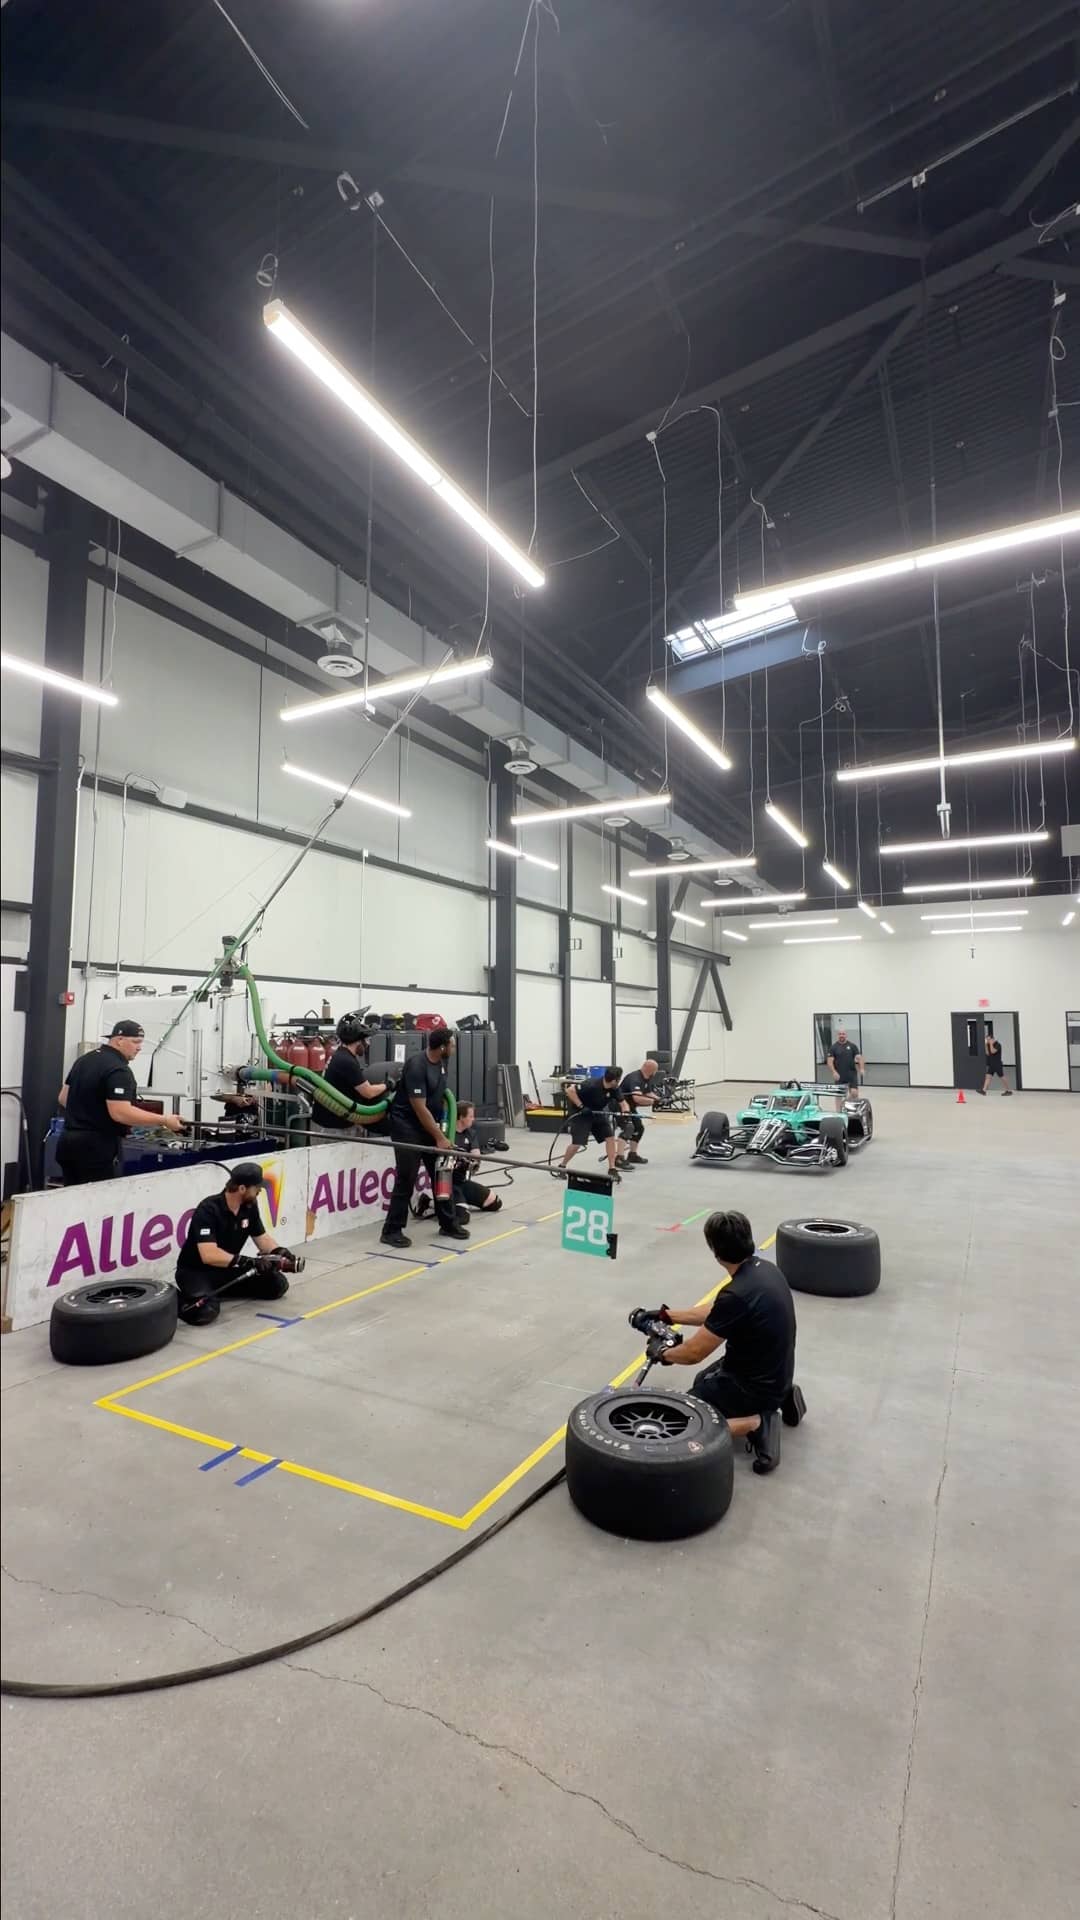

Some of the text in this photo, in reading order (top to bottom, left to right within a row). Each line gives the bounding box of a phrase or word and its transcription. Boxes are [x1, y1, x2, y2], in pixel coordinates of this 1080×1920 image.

[310, 1167, 432, 1214] Allega
[47, 1208, 196, 1287] Alle
[566, 1206, 609, 1246] 28
